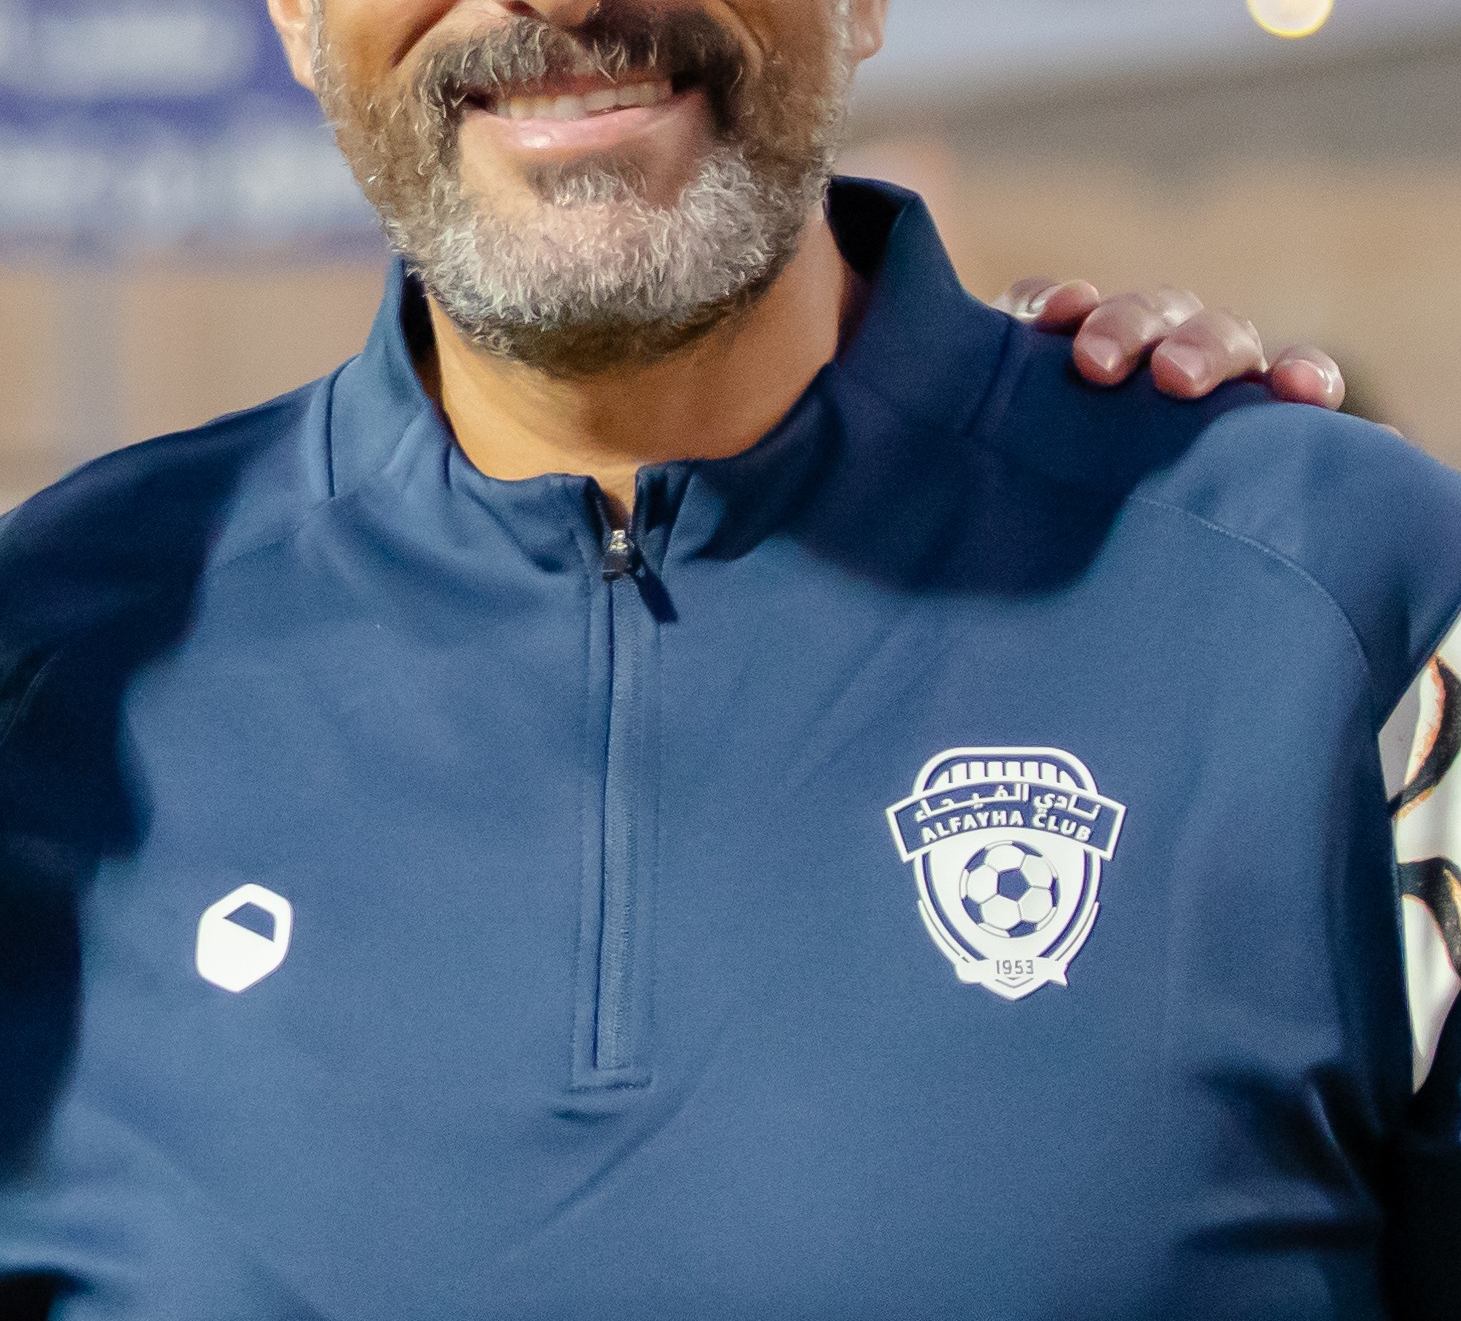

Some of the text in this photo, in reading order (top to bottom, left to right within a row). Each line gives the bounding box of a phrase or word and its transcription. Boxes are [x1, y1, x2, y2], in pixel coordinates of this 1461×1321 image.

[914, 783, 1102, 822] نادي الفيحاء
[921, 810, 1093, 843] ALFAYHA CLUB
[995, 959, 1034, 975] 1953
